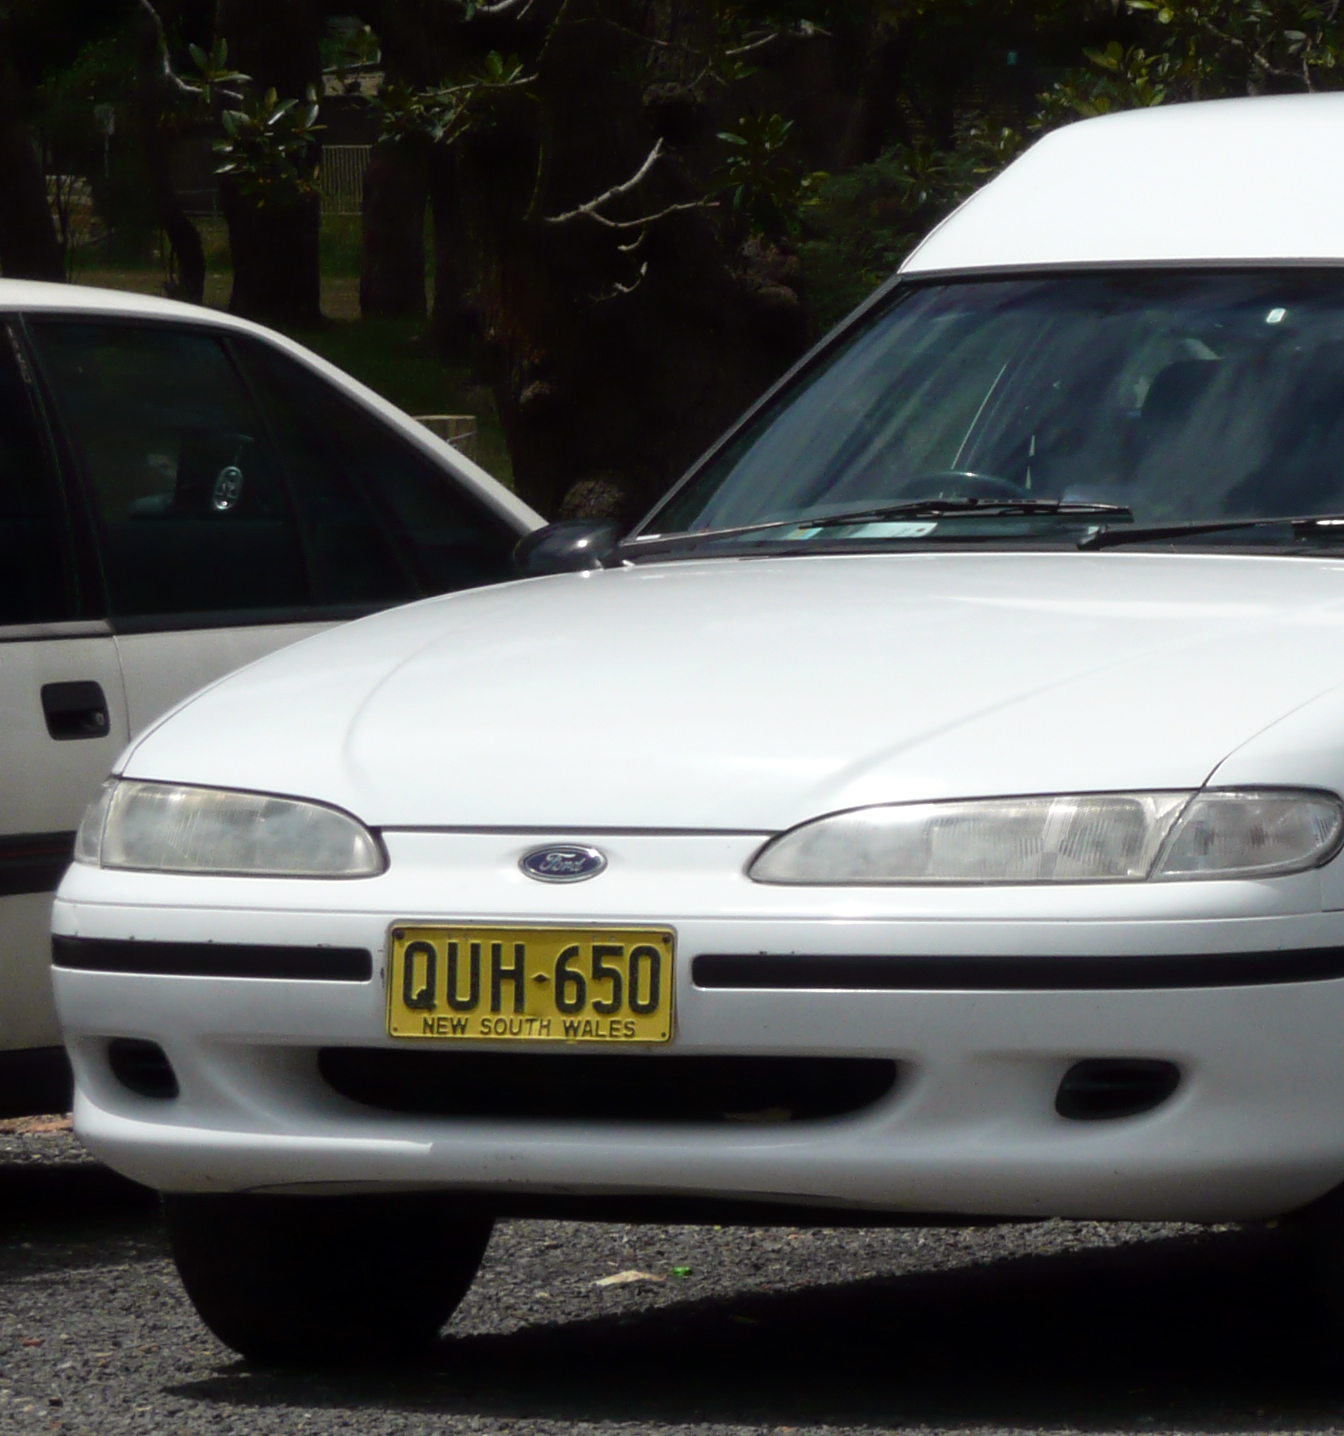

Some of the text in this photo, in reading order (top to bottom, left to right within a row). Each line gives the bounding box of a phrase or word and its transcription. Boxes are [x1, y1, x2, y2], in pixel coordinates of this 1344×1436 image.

[539, 852, 587, 873] Ford
[422, 1016, 636, 1038] NEW SOUTH WALES
